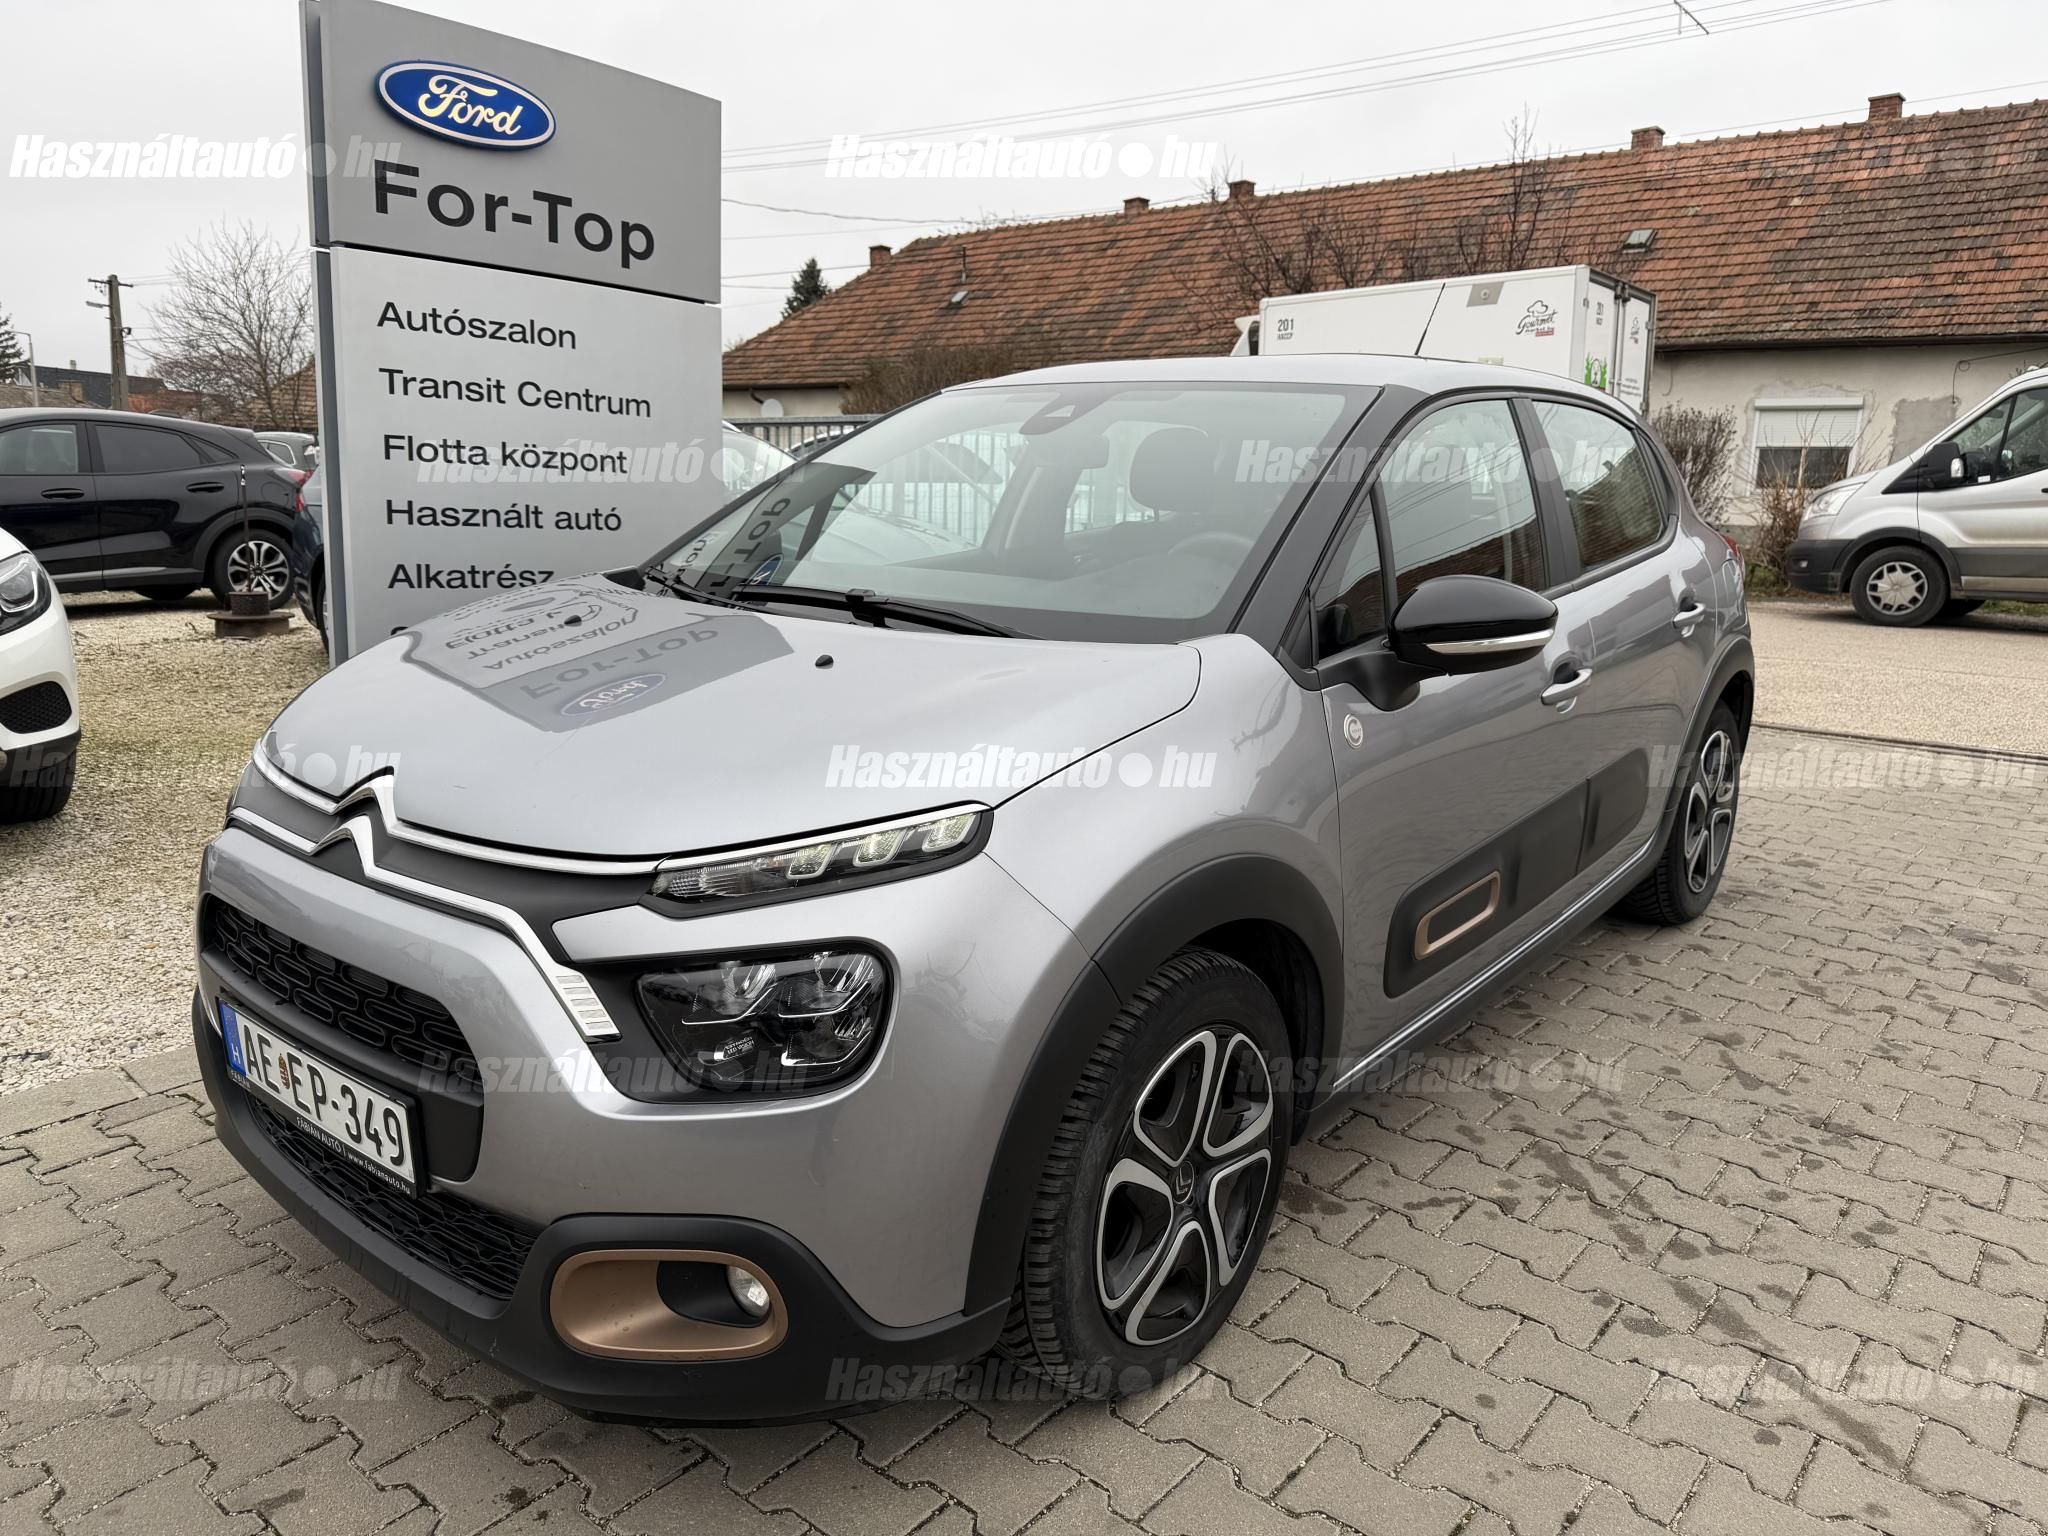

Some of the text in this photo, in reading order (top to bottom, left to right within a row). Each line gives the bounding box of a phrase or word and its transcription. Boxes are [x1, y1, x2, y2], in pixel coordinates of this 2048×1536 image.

[417, 74, 523, 135] Ford
[374, 159, 655, 269] For-Top
[376, 301, 577, 350] Autószalon
[1277, 318, 1294, 332] 201
[378, 367, 651, 418] Transit Centrum
[384, 434, 628, 476] Flotta központ
[386, 499, 622, 531] Használt autó
[387, 563, 555, 589] Alkatrész
[231, 1043, 242, 1065] H
[243, 1024, 405, 1167] AE EP-349
